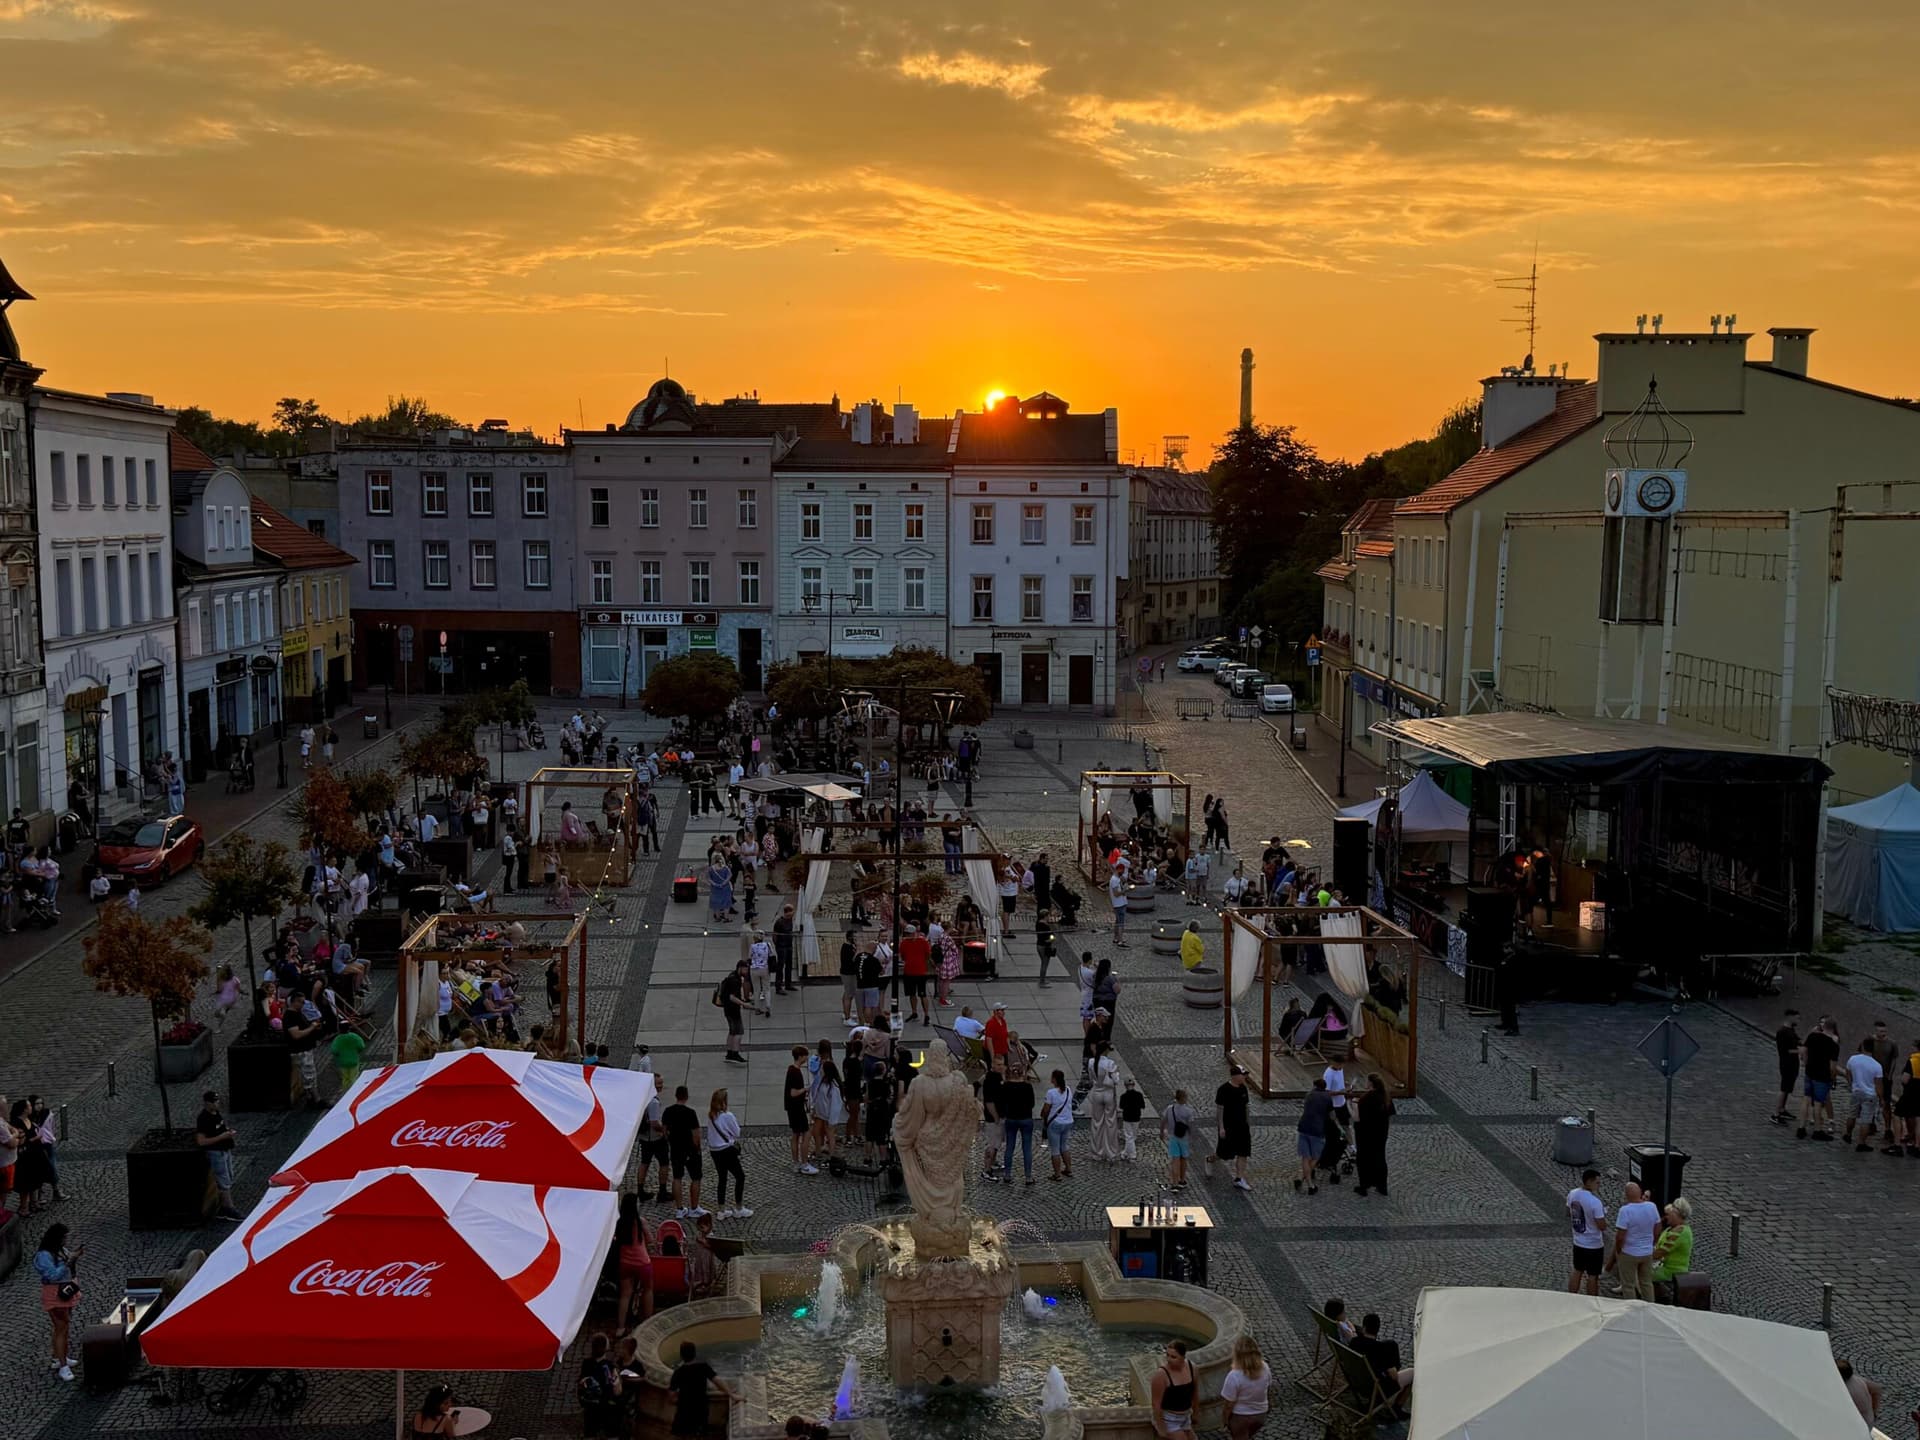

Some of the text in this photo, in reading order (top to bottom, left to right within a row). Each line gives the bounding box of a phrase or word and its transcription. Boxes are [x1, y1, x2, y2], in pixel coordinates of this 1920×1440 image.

[623, 613, 681, 623] DELIKATESY
[1309, 648, 1317, 659] P
[390, 1118, 517, 1149] Coca-Cola
[289, 1258, 447, 1297] Coca-Cola
